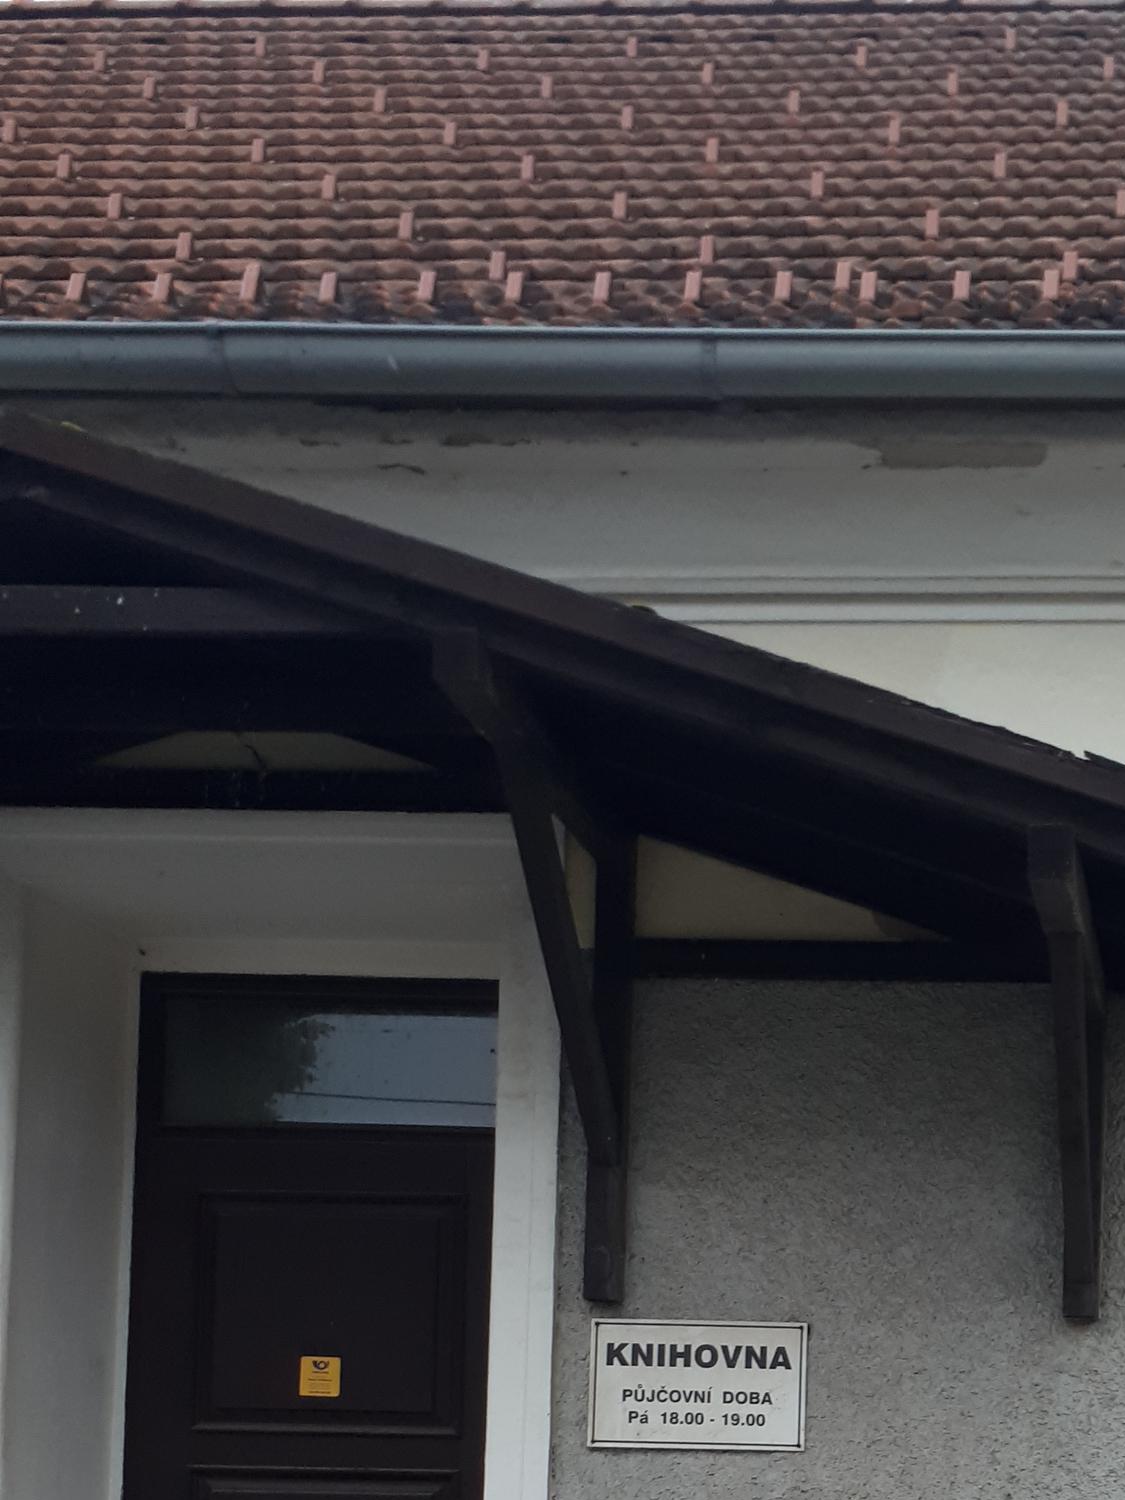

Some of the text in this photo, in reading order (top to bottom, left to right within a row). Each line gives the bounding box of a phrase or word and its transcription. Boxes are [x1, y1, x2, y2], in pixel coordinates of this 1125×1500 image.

[605, 1342, 793, 1370] KNIHOVNA
[622, 1384, 773, 1405] PŮJČOVNÍ DOBA
[628, 1410, 649, 1424] Pá
[660, 1411, 704, 1425] 18.00
[721, 1413, 766, 1426] 19.00
